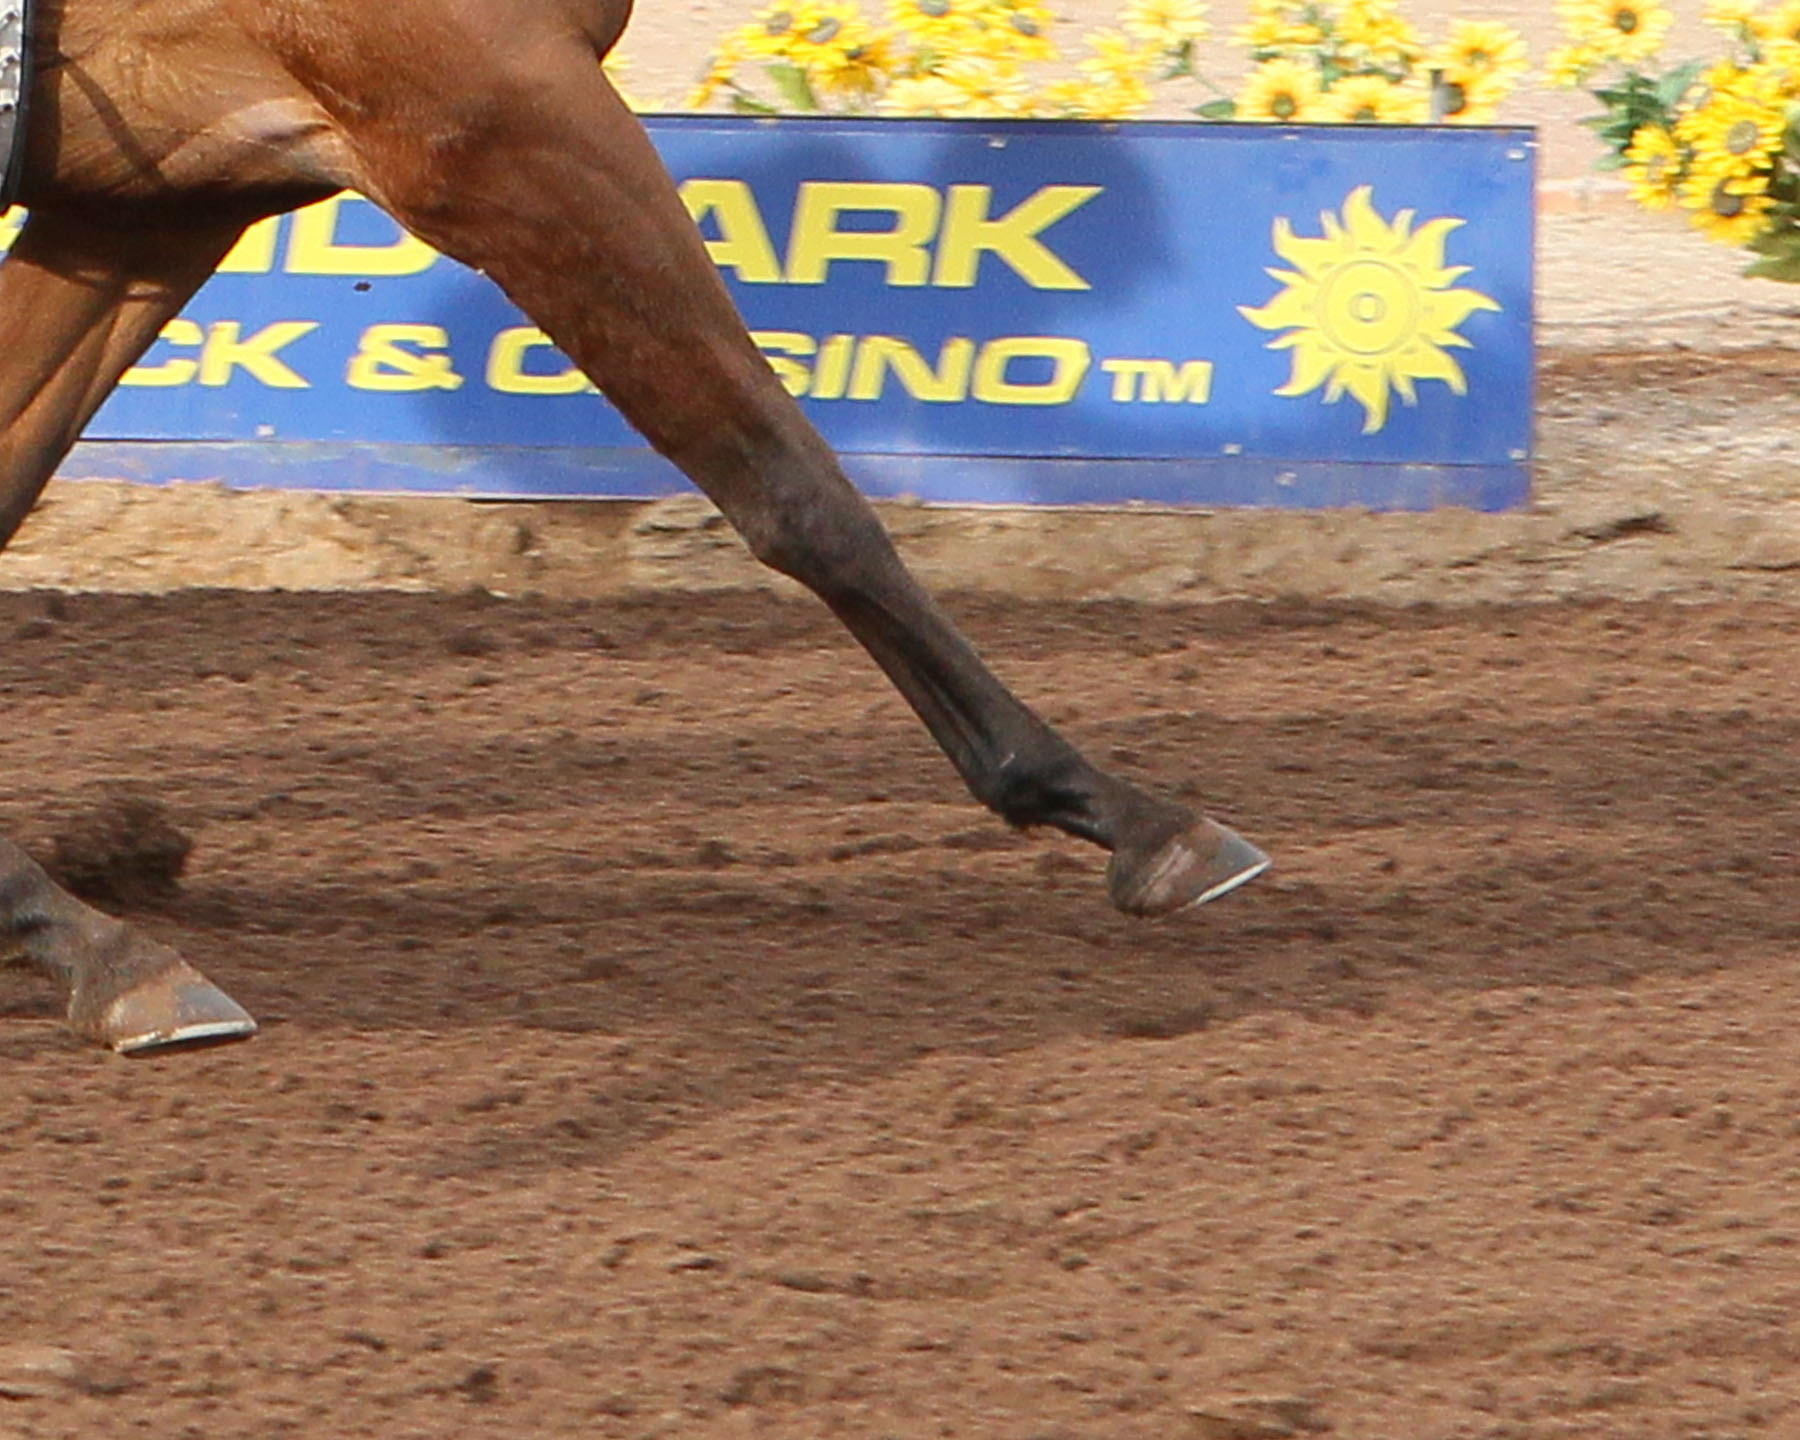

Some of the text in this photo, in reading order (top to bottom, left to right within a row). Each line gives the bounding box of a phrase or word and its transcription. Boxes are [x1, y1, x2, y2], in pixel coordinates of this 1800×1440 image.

[678, 179, 1104, 290] ARK
[347, 324, 463, 392] &
[486, 327, 1092, 404] CSINO
